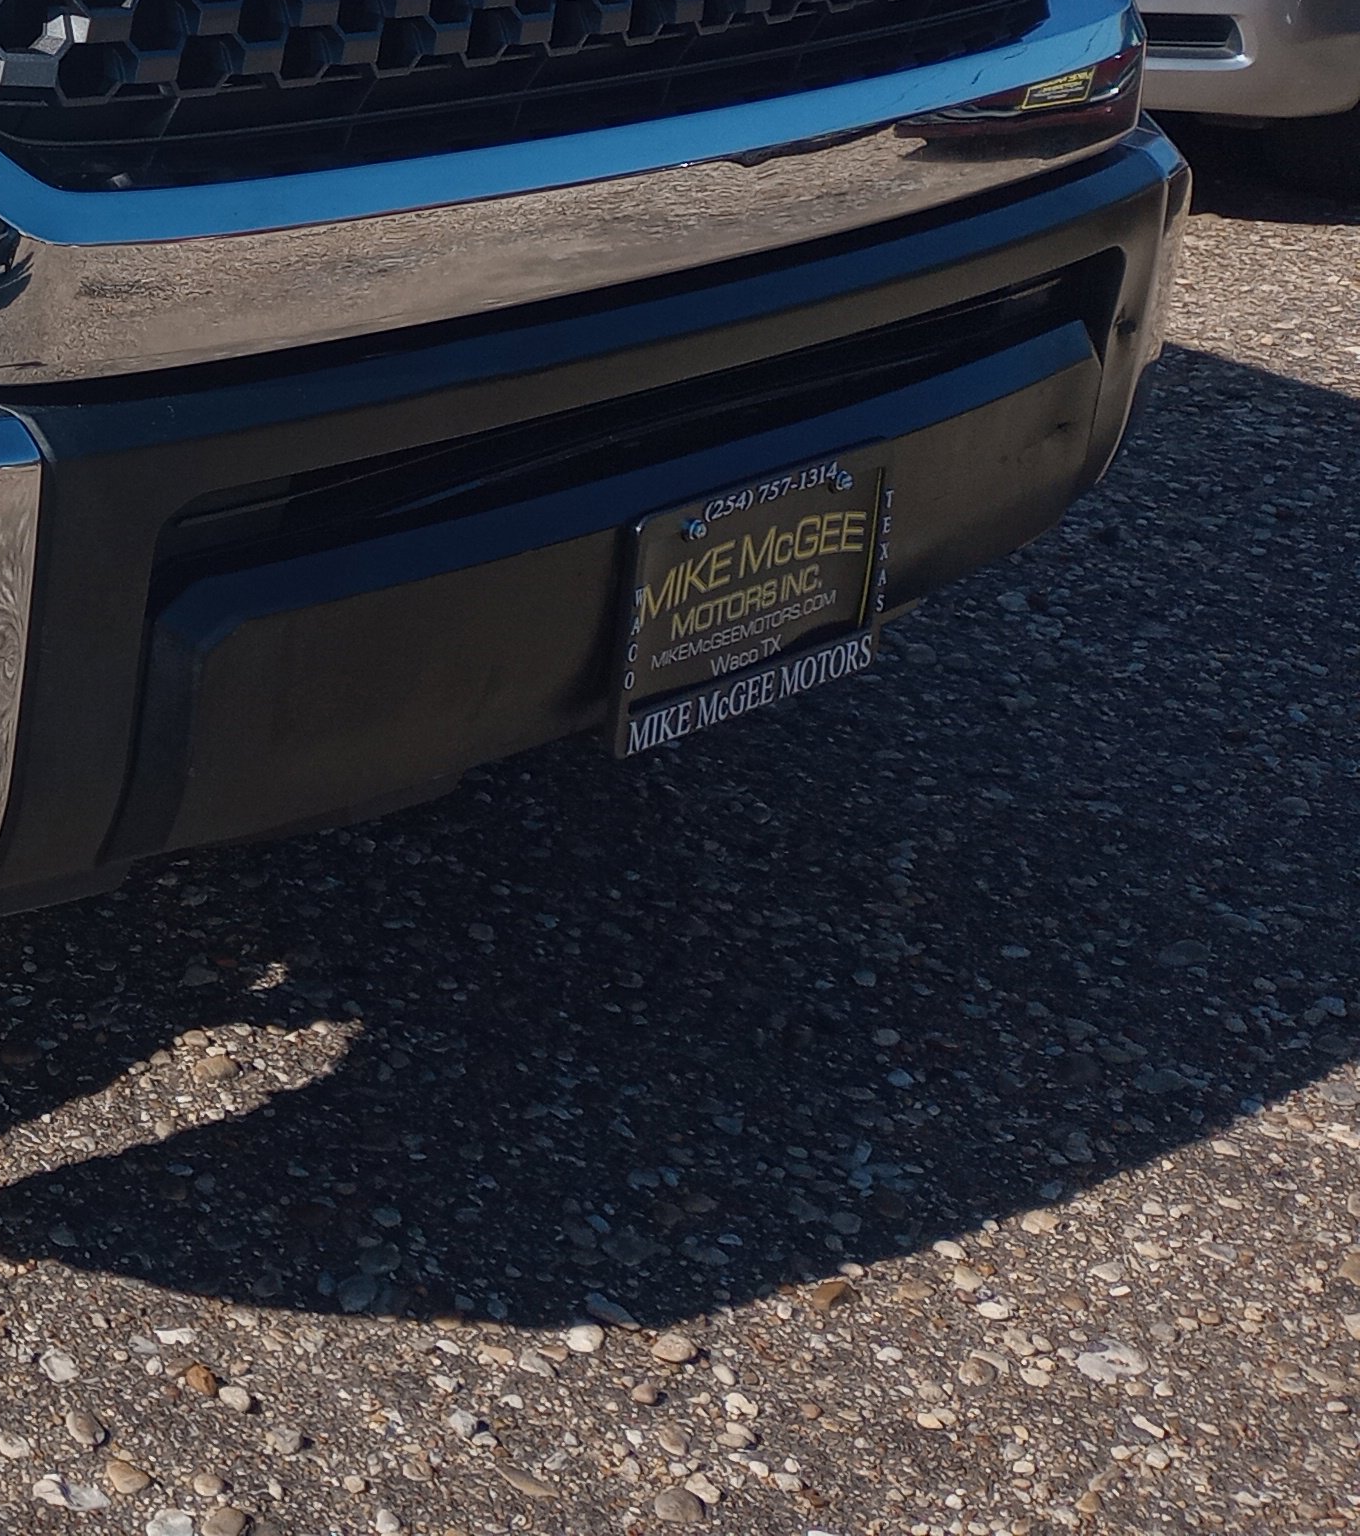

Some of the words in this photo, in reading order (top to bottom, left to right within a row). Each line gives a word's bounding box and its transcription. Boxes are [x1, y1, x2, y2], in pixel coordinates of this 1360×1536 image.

[704, 488, 753, 522] (254)
[759, 462, 838, 504] 757-1314
[640, 539, 735, 626] MIKE
[738, 511, 867, 579] McGEE
[875, 489, 895, 612] TEXAS
[670, 579, 777, 641] MOTORS
[779, 564, 823, 602] INC.
[626, 701, 693, 756] MIKE
[695, 670, 776, 731] McGEE
[779, 635, 873, 698] MOTORS
[711, 645, 759, 677] Waco
[761, 634, 783, 655] TX
